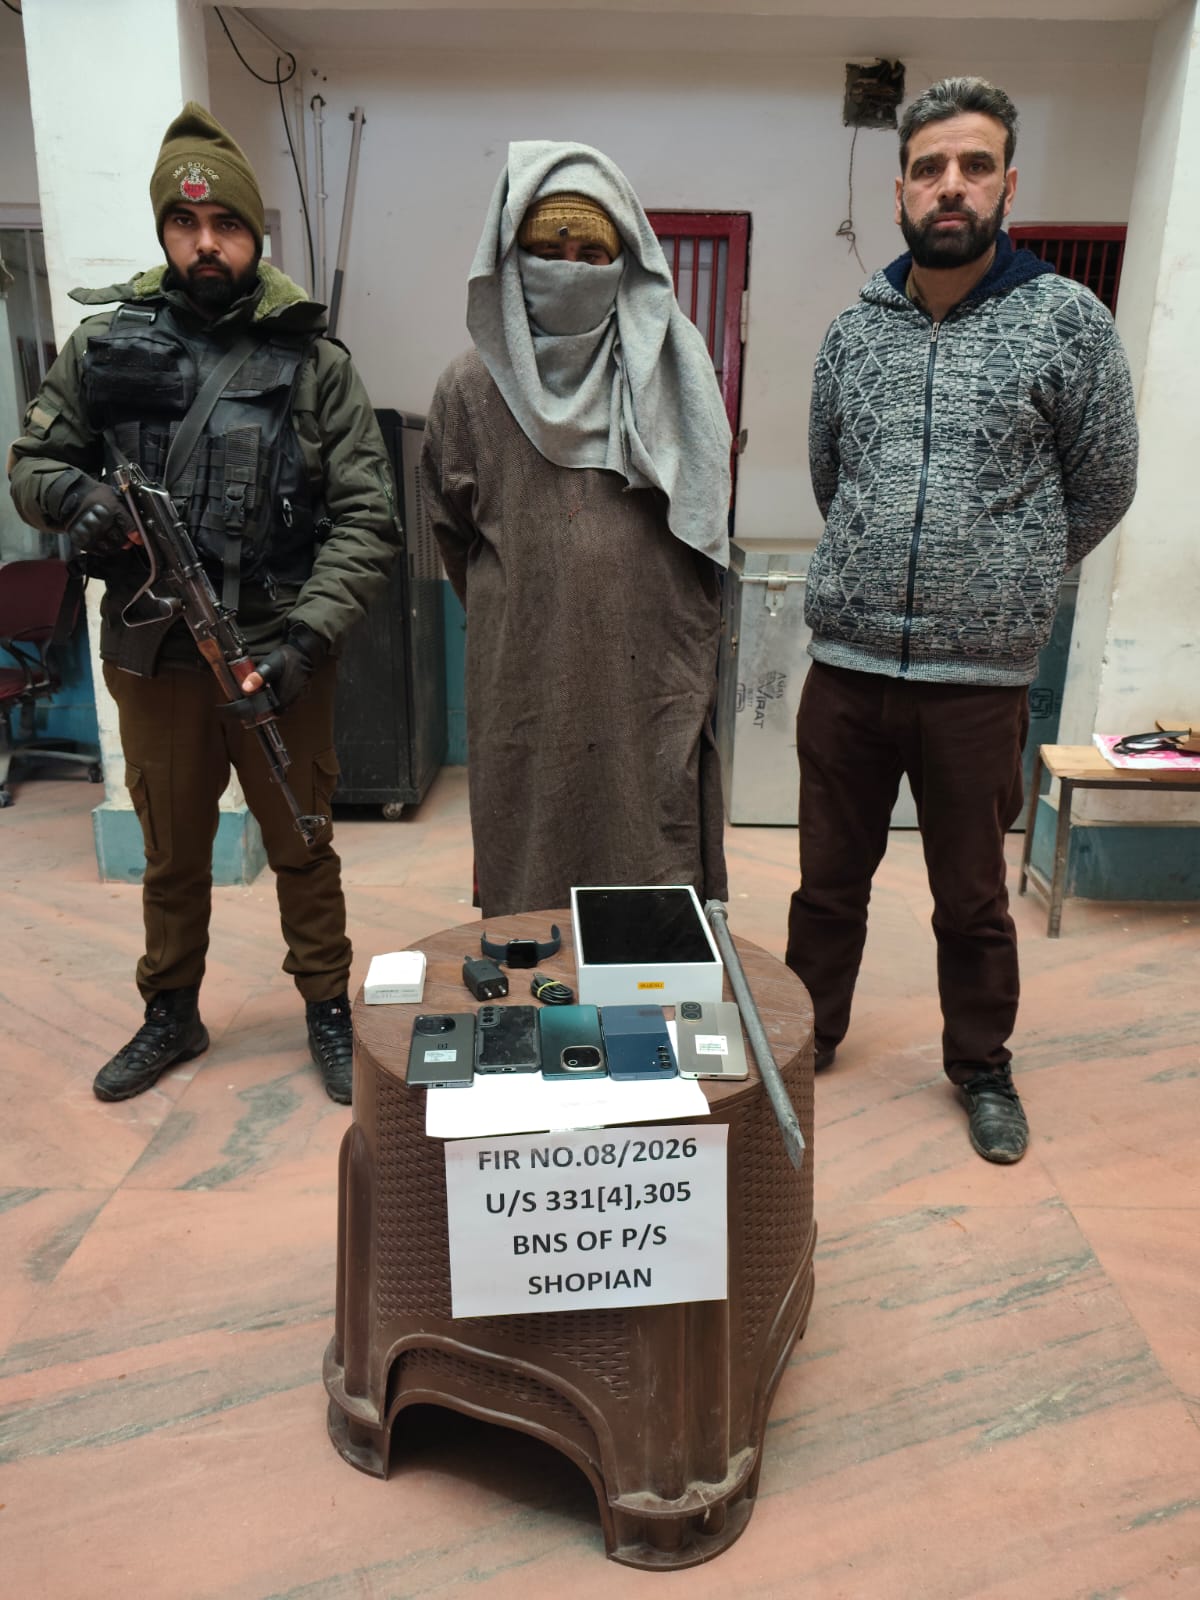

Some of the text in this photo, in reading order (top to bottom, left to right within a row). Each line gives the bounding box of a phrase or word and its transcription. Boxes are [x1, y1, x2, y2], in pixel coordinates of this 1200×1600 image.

[172, 161, 220, 181] J&K POLICE
[753, 679, 776, 729] VIRAT
[478, 1137, 697, 1171] FIR NO.08/2026
[486, 1181, 691, 1218] U/S 331[4],305
[513, 1224, 667, 1256] BNS OF P/S
[528, 1267, 652, 1295] SHOPIAN
